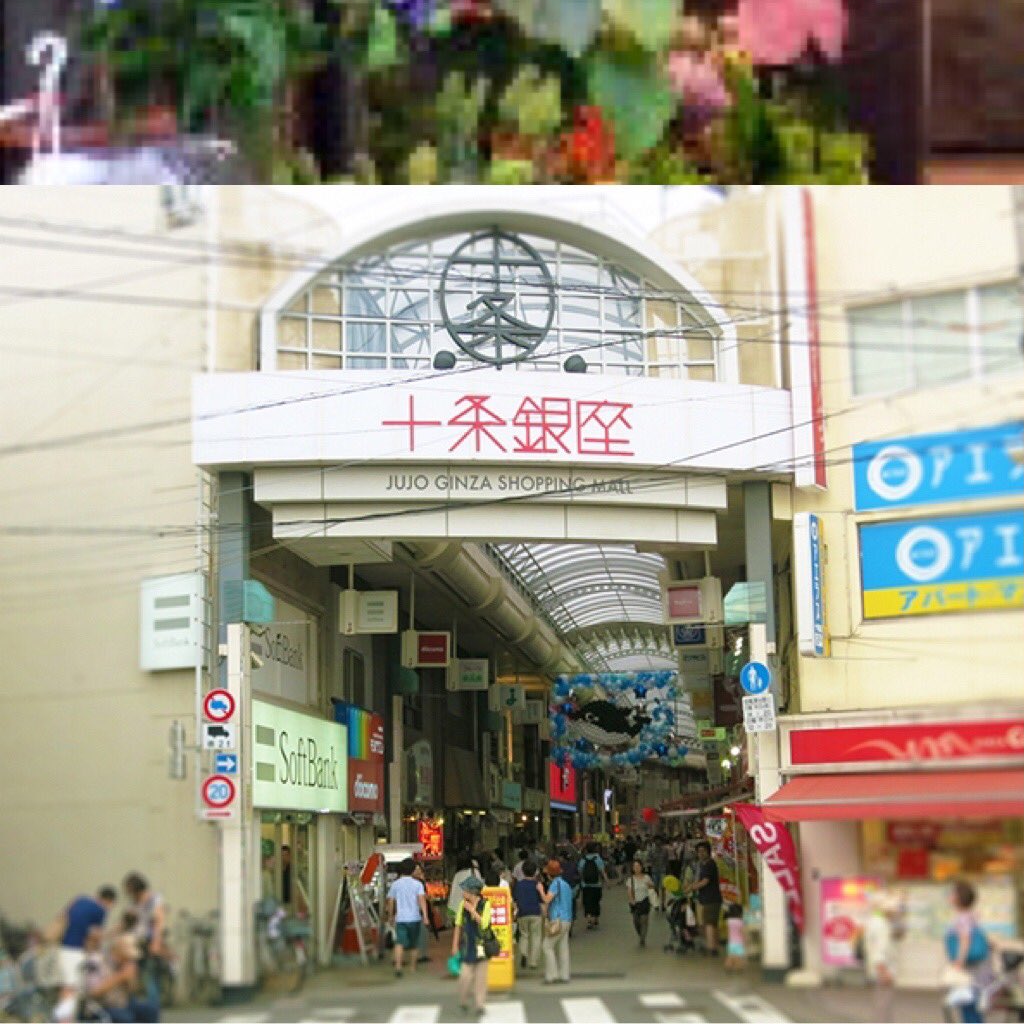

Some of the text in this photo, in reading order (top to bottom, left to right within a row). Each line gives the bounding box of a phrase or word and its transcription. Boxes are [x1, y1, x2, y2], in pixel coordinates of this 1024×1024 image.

[382, 394, 634, 456] 十条銀座
[386, 474, 634, 494] JUJO GINZA SHOPPING MALL
[279, 731, 338, 789] SoftBank
[209, 783, 229, 799] 20
